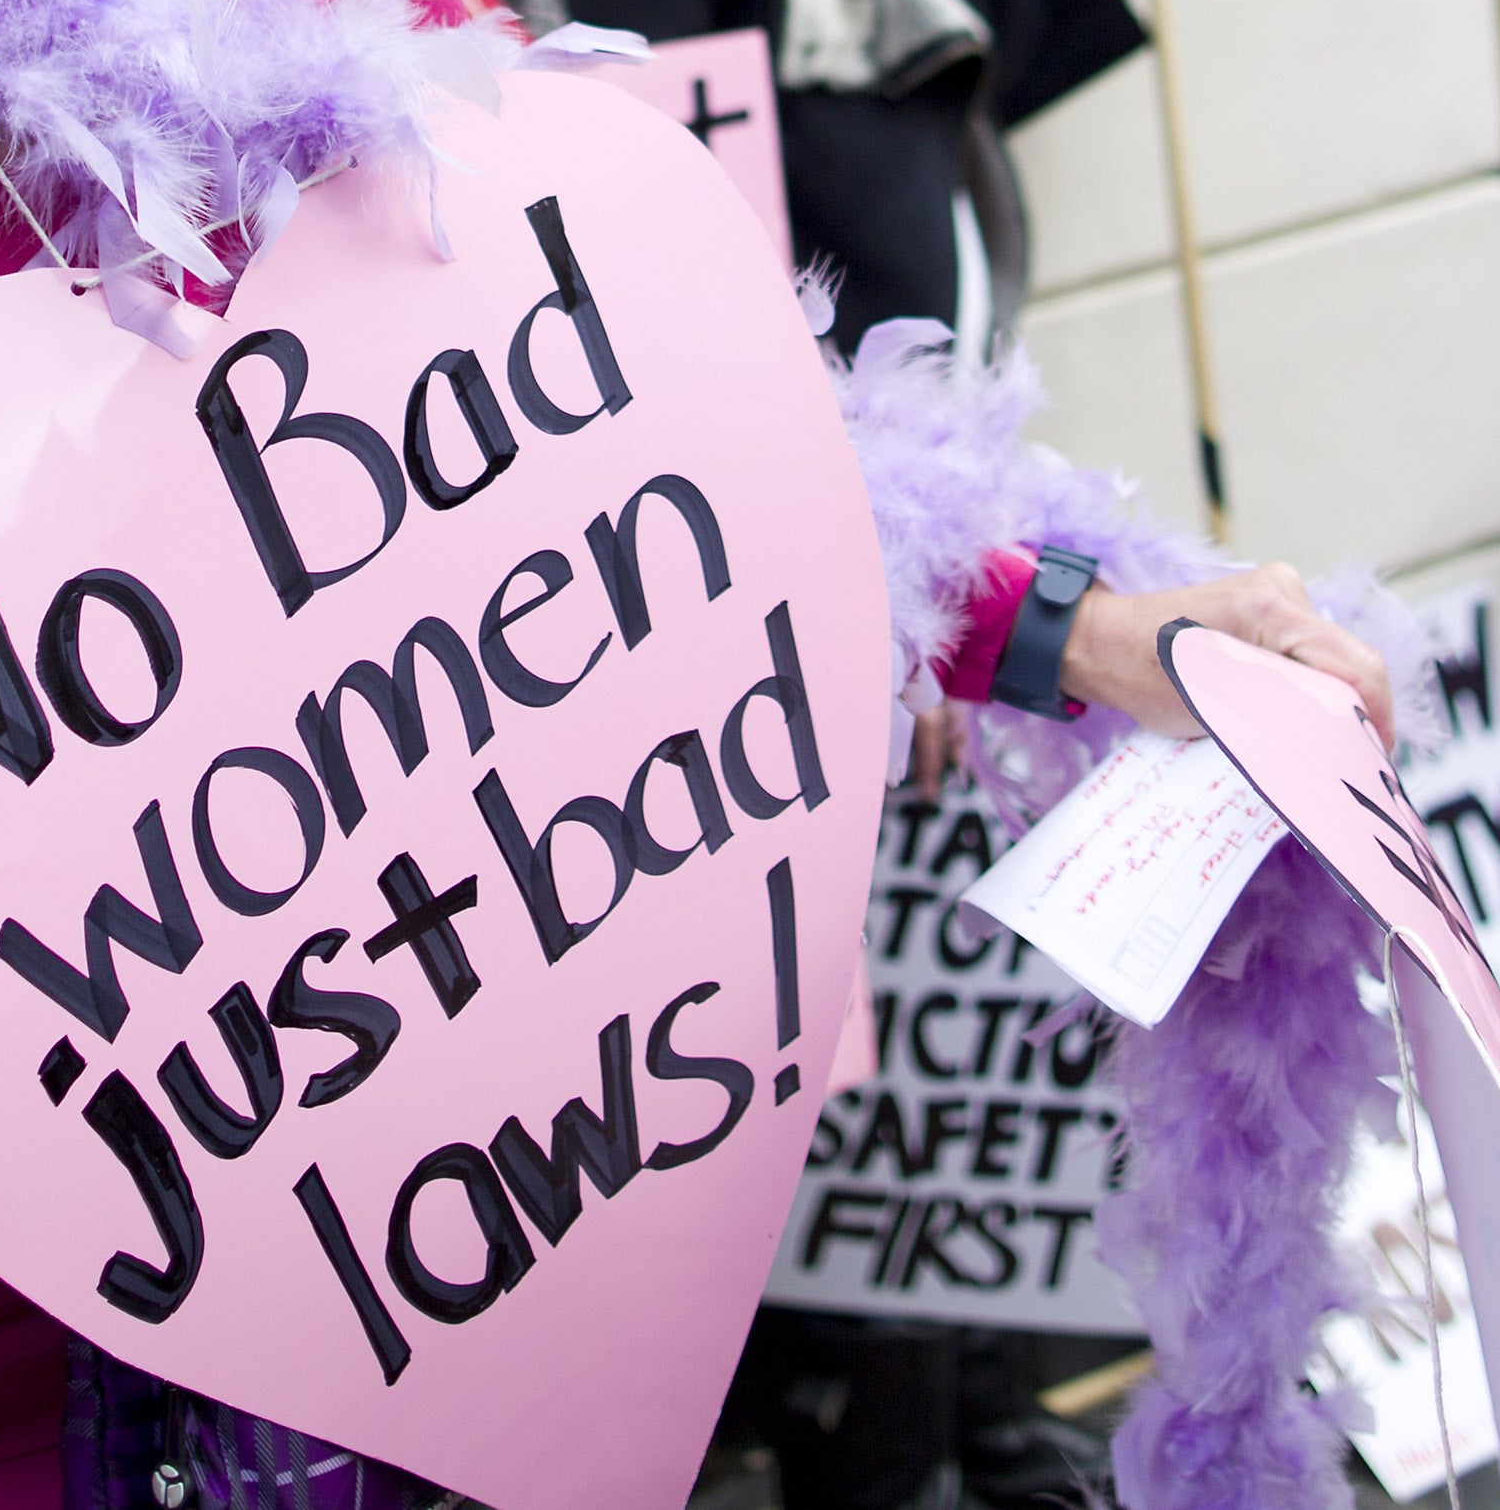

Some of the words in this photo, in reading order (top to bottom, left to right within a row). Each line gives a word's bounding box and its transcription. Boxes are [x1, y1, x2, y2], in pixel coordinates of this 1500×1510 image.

[194, 195, 635, 619] Bad
[36, 851, 482, 1326] just
[471, 599, 833, 968] bad
[290, 855, 804, 1387] laws!
[802, 1188, 1093, 1288] FIRST
